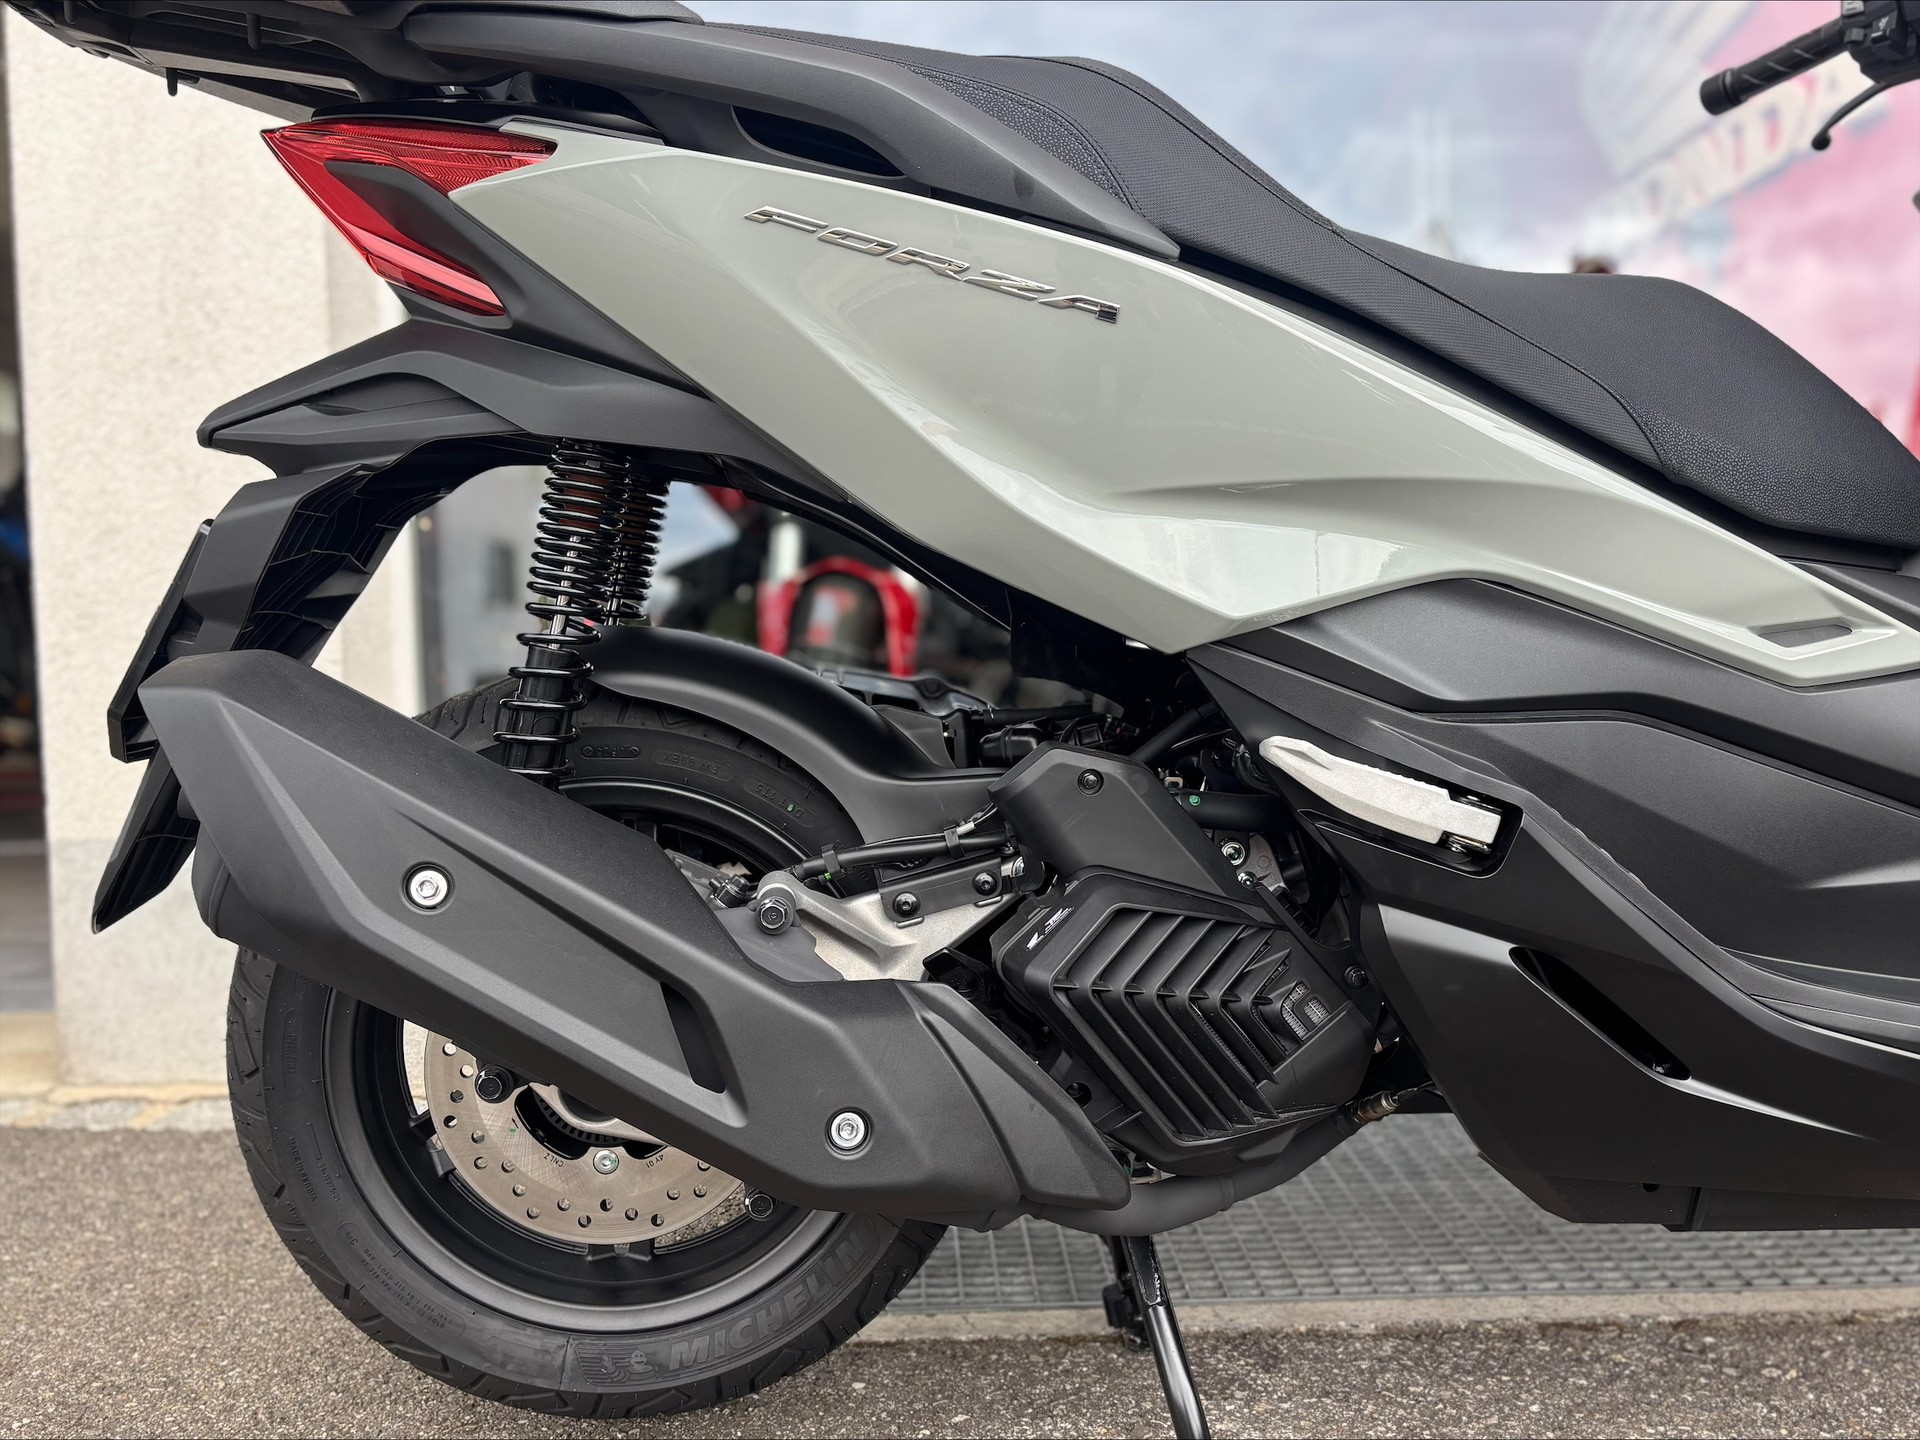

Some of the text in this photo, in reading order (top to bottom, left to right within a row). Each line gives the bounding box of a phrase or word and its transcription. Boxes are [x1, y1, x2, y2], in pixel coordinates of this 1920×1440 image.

[743, 204, 1121, 324] FORZA
[541, 1151, 566, 1168] CNLZ
[669, 1226, 872, 1372] MICHELIN
